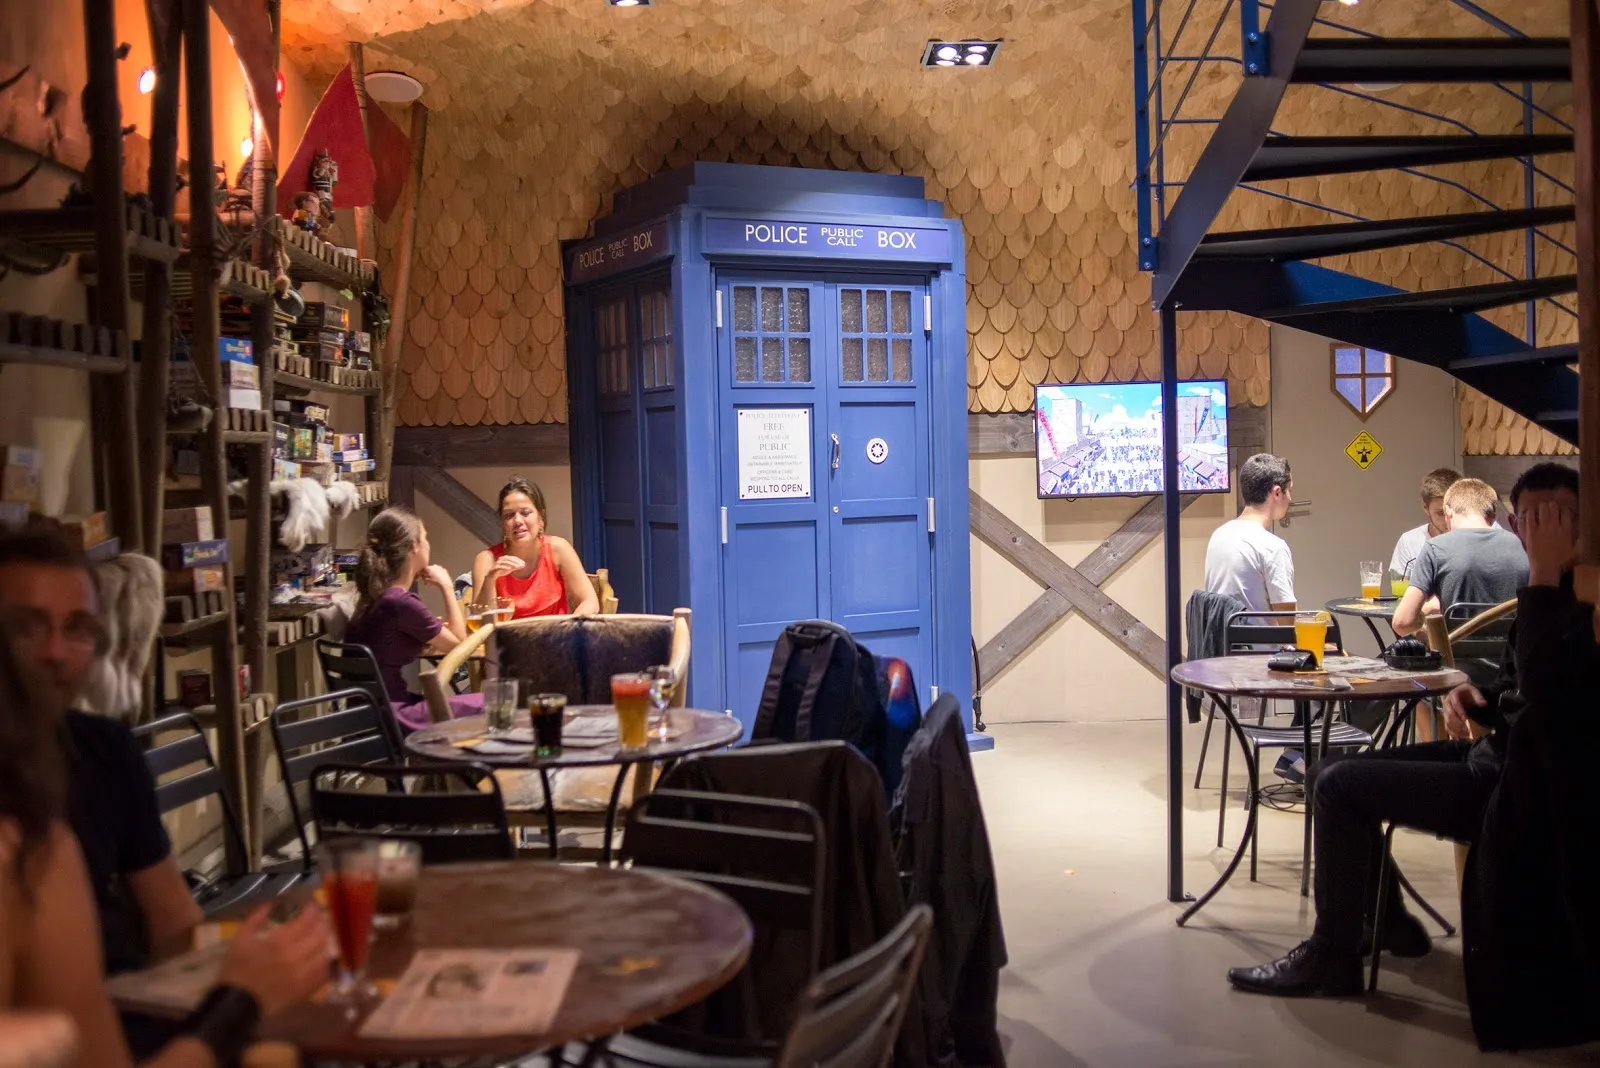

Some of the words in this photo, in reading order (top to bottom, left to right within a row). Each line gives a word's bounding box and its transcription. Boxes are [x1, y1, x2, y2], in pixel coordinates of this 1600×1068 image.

[745, 224, 808, 244] POLICE
[821, 227, 864, 238] PUBLIC
[607, 237, 628, 252] PUBLIC
[633, 230, 653, 252] BOX
[826, 236, 858, 247] CALL
[877, 230, 917, 249] BOX
[579, 246, 605, 269] POLICE
[611, 248, 625, 260] CALL
[763, 422, 785, 431] FREE
[759, 443, 790, 451] PUBLIC
[747, 484, 768, 494] PULL
[768, 484, 780, 493] TO
[780, 483, 803, 493] OPEN
